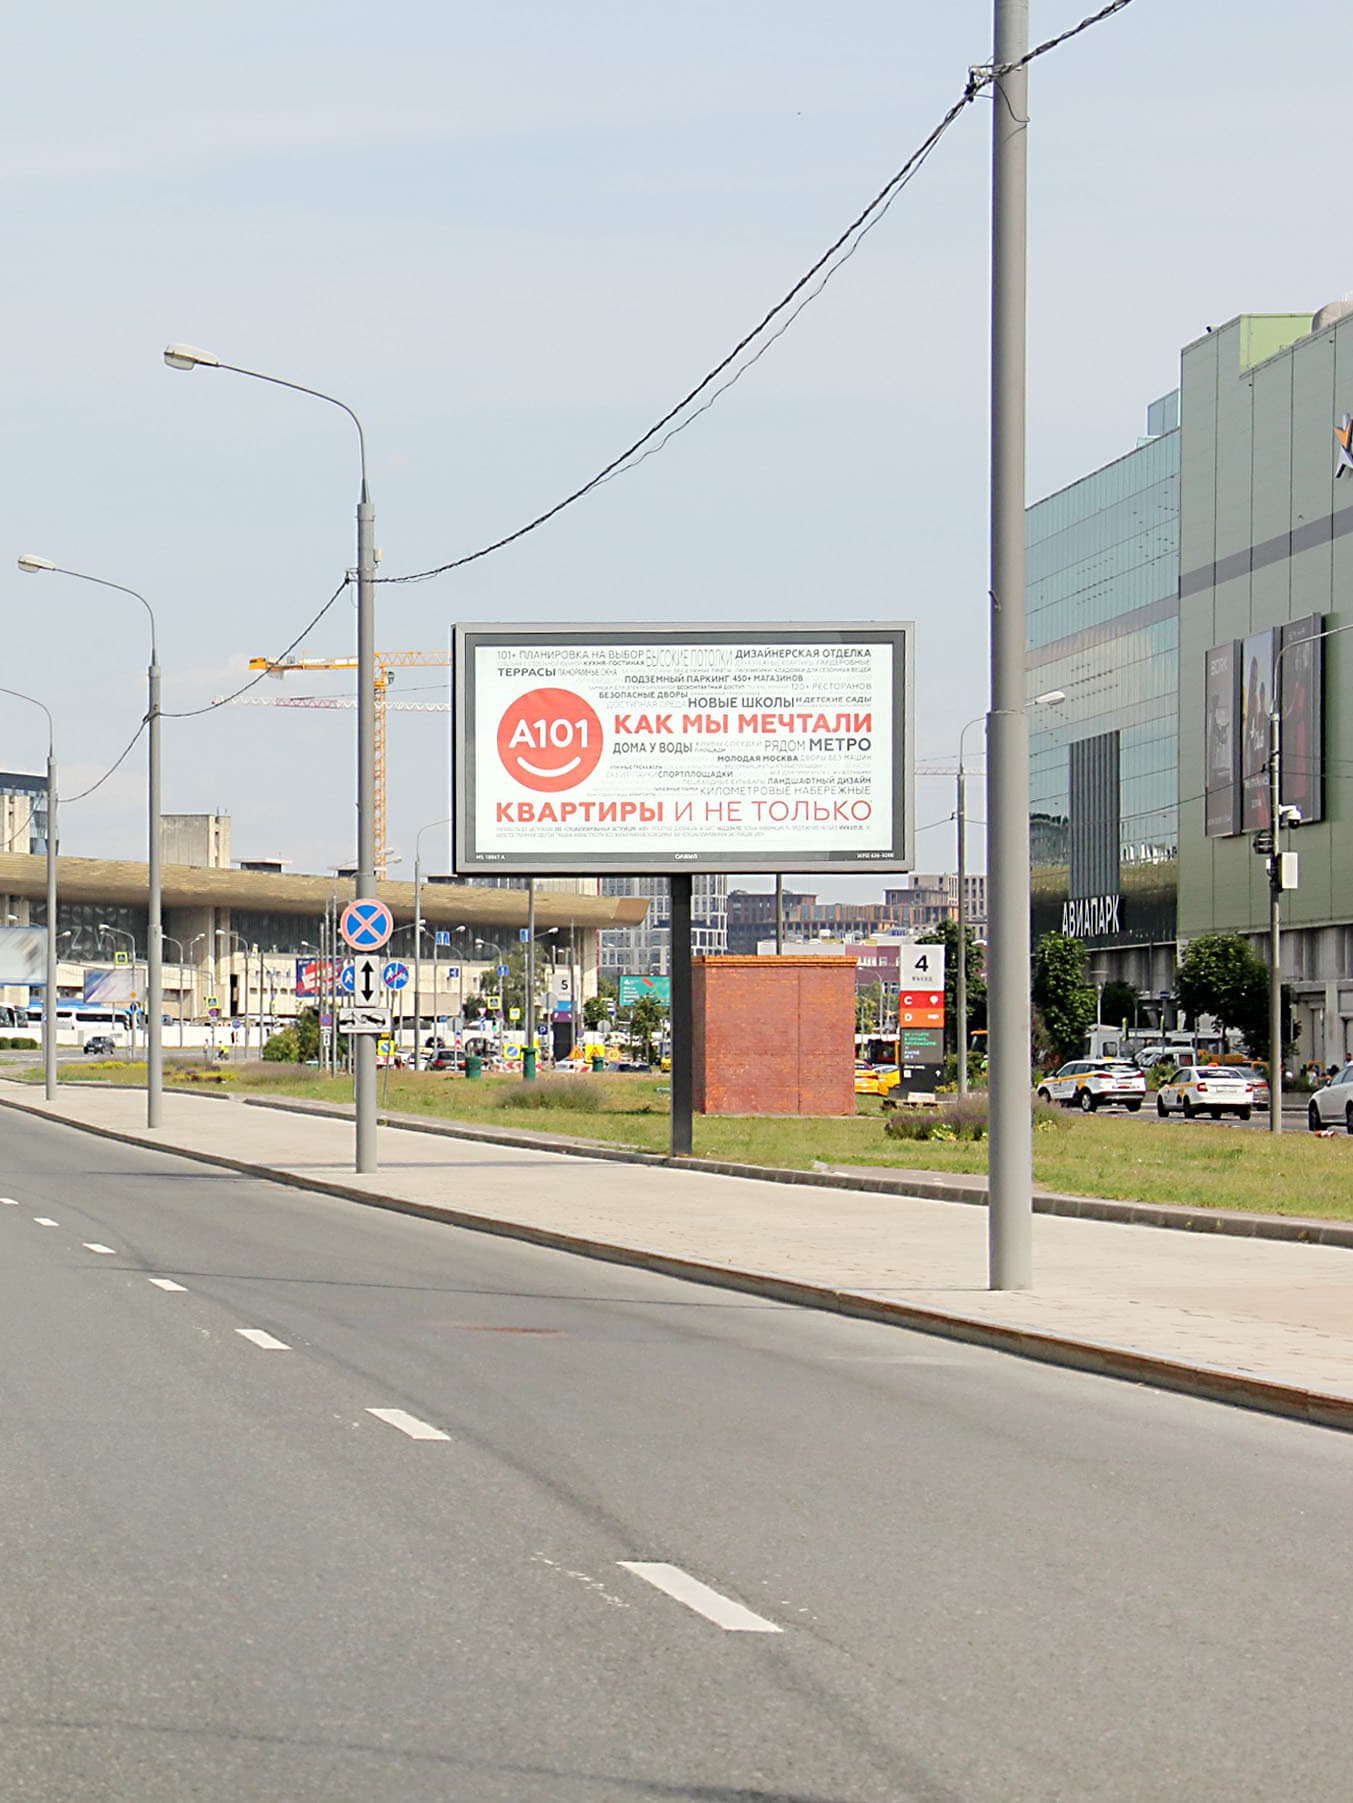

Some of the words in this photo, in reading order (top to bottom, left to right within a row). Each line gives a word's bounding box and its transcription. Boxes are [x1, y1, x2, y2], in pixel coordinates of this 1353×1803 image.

[498, 650, 516, 660] 101+
[519, 649, 589, 660] ПЛАНИРОВКА
[591, 650, 606, 659] НА
[608, 649, 645, 660] ВЫБОР
[735, 648, 820, 659] ДИЗАЙНЕРСКАЯ
[822, 649, 872, 659] ОТДЕЛКА
[498, 668, 557, 677] ТЕРРАСЫ
[624, 674, 685, 684] ПОДЗЕМНЫЙ
[687, 675, 730, 683] ПАРКИНГ
[732, 674, 752, 682] 450+
[754, 674, 804, 683] МАГАЗИНОВ
[812, 682, 872, 690] РЕСТОРАНОВ
[598, 691, 654, 699] БЕЗОПАСНЫЕ
[657, 691, 688, 700] ДВОРЫ
[688, 697, 738, 708] НОВЫЕ
[741, 697, 795, 708] ШКОЛЫ
[614, 713, 674, 735] КАК
[682, 713, 729, 735] МЫ
[738, 713, 873, 734] МЕЧТАЛИ
[612, 742, 647, 755] ДОМА
[649, 742, 657, 754] У
[659, 742, 693, 755] ВОДЫ
[764, 739, 806, 753] РЯДОМ
[809, 738, 872, 751] МЕТРО
[717, 755, 762, 763] МОЛОДАЯ
[657, 770, 734, 778] СПОРТПЛОЩАДКИ
[767, 776, 835, 785] ЛАНДШАФТНЫЙ
[837, 776, 872, 785] ДИЗАЙН
[700, 786, 792, 796] КИЛОМЕТРОВЫЕ
[794, 786, 871, 796] НАБЕРЕЖНЫЕ
[496, 801, 664, 823] КВАРТИРЫ
[674, 801, 693, 822] И
[705, 801, 743, 822] НЕ
[751, 800, 872, 822] ТОЛЬКО
[1062, 894, 1120, 938] АВИАПАРК
[914, 954, 929, 973] 4
[561, 979, 569, 990] 5
